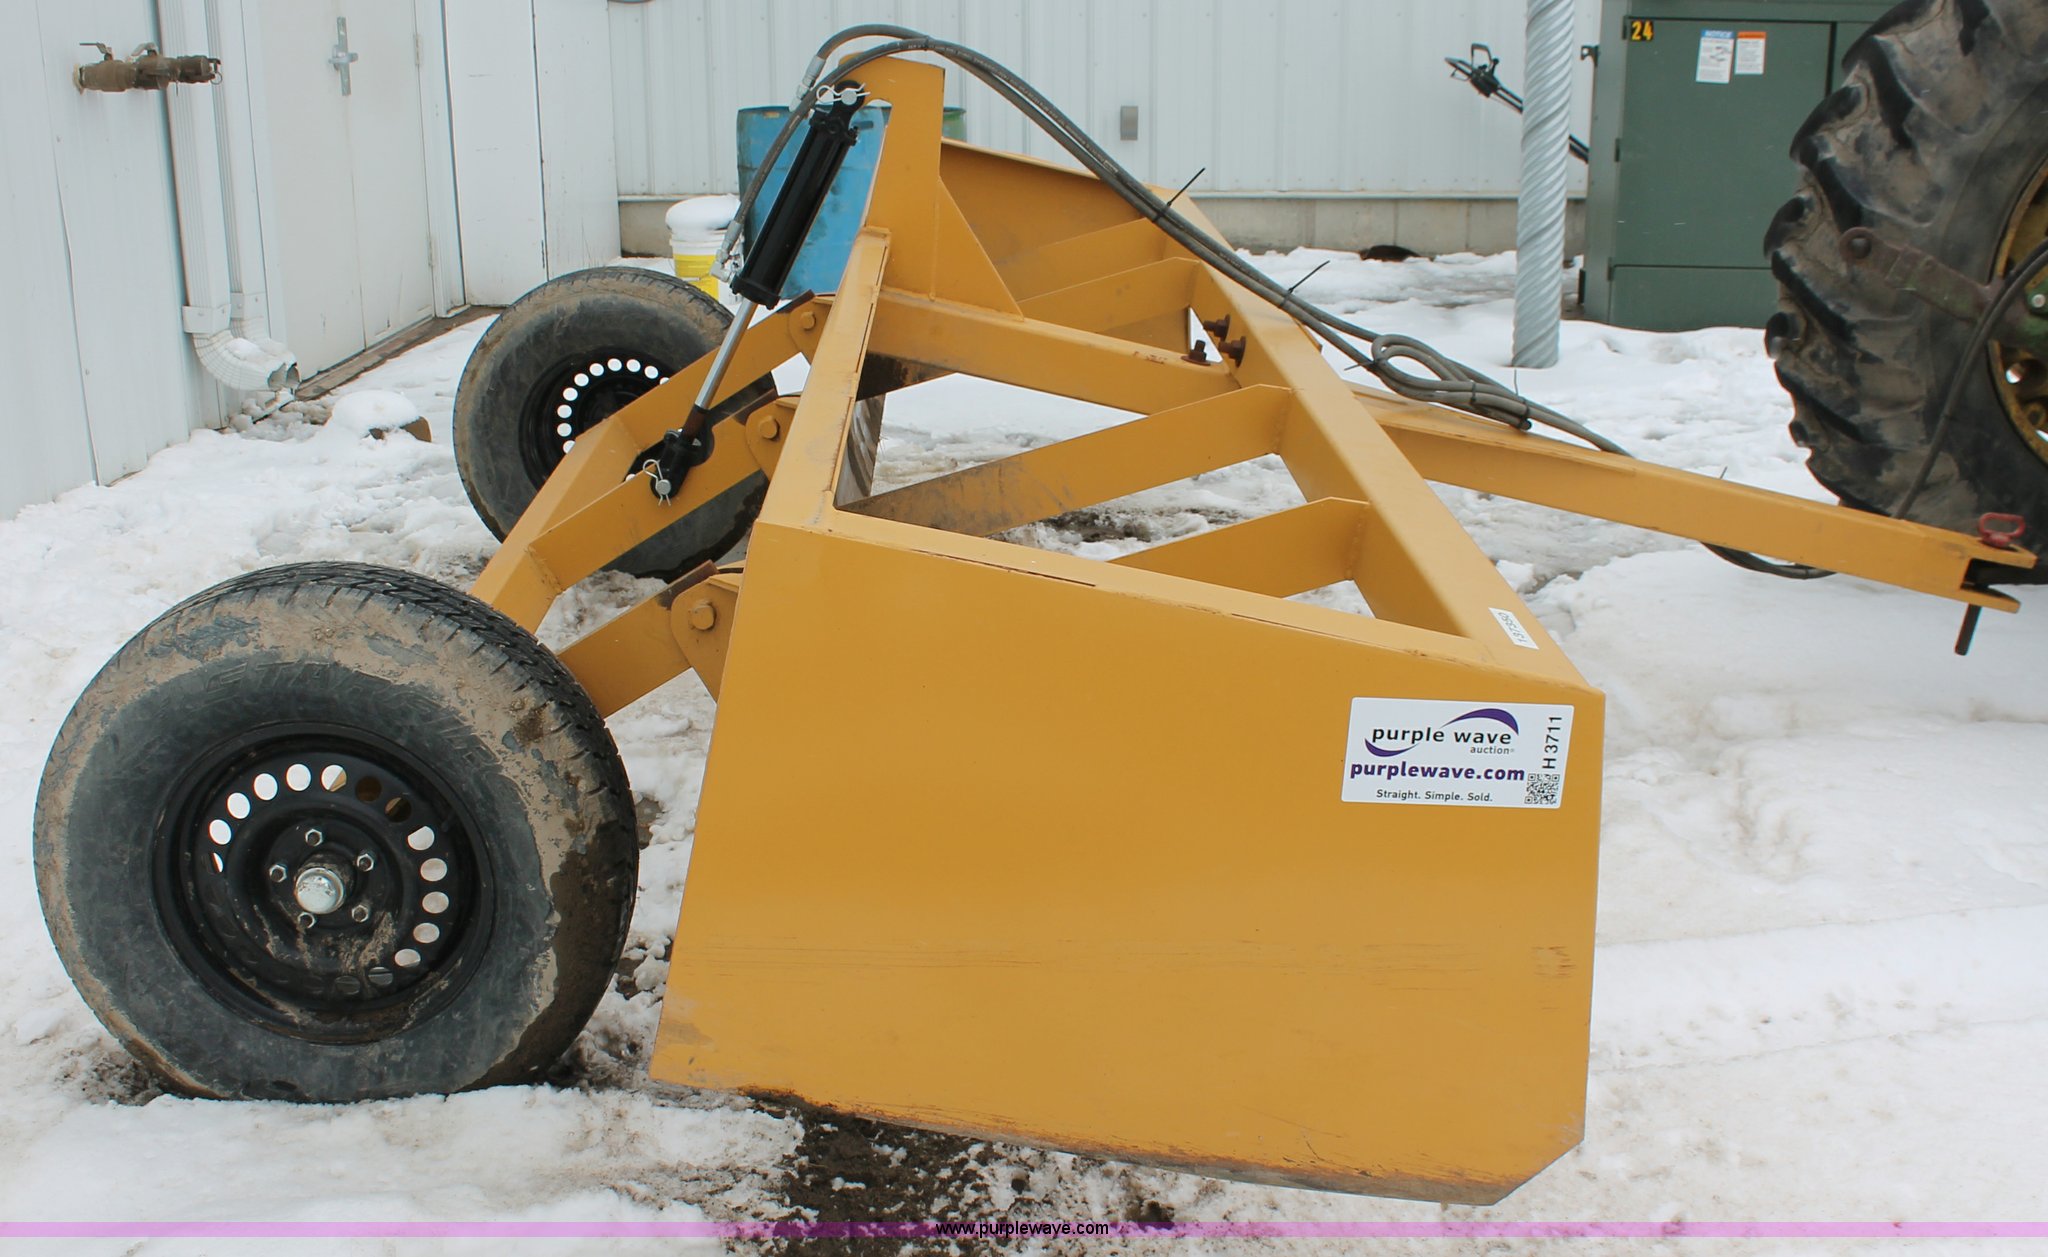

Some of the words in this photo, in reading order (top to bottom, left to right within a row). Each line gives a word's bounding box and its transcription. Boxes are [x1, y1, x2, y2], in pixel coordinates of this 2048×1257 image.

[1631, 21, 1654, 41] 24
[1372, 727, 1445, 744] purple
[1453, 731, 1512, 745] wave
[1544, 717, 1562, 754] 3711
[1470, 746, 1510, 755] auction
[1350, 761, 1525, 781] purplewave.com
[1542, 758, 1557, 769] H
[1376, 789, 1421, 800] Straight.
[1424, 791, 1464, 802] Simple.
[1467, 792, 1493, 802] Sold.
